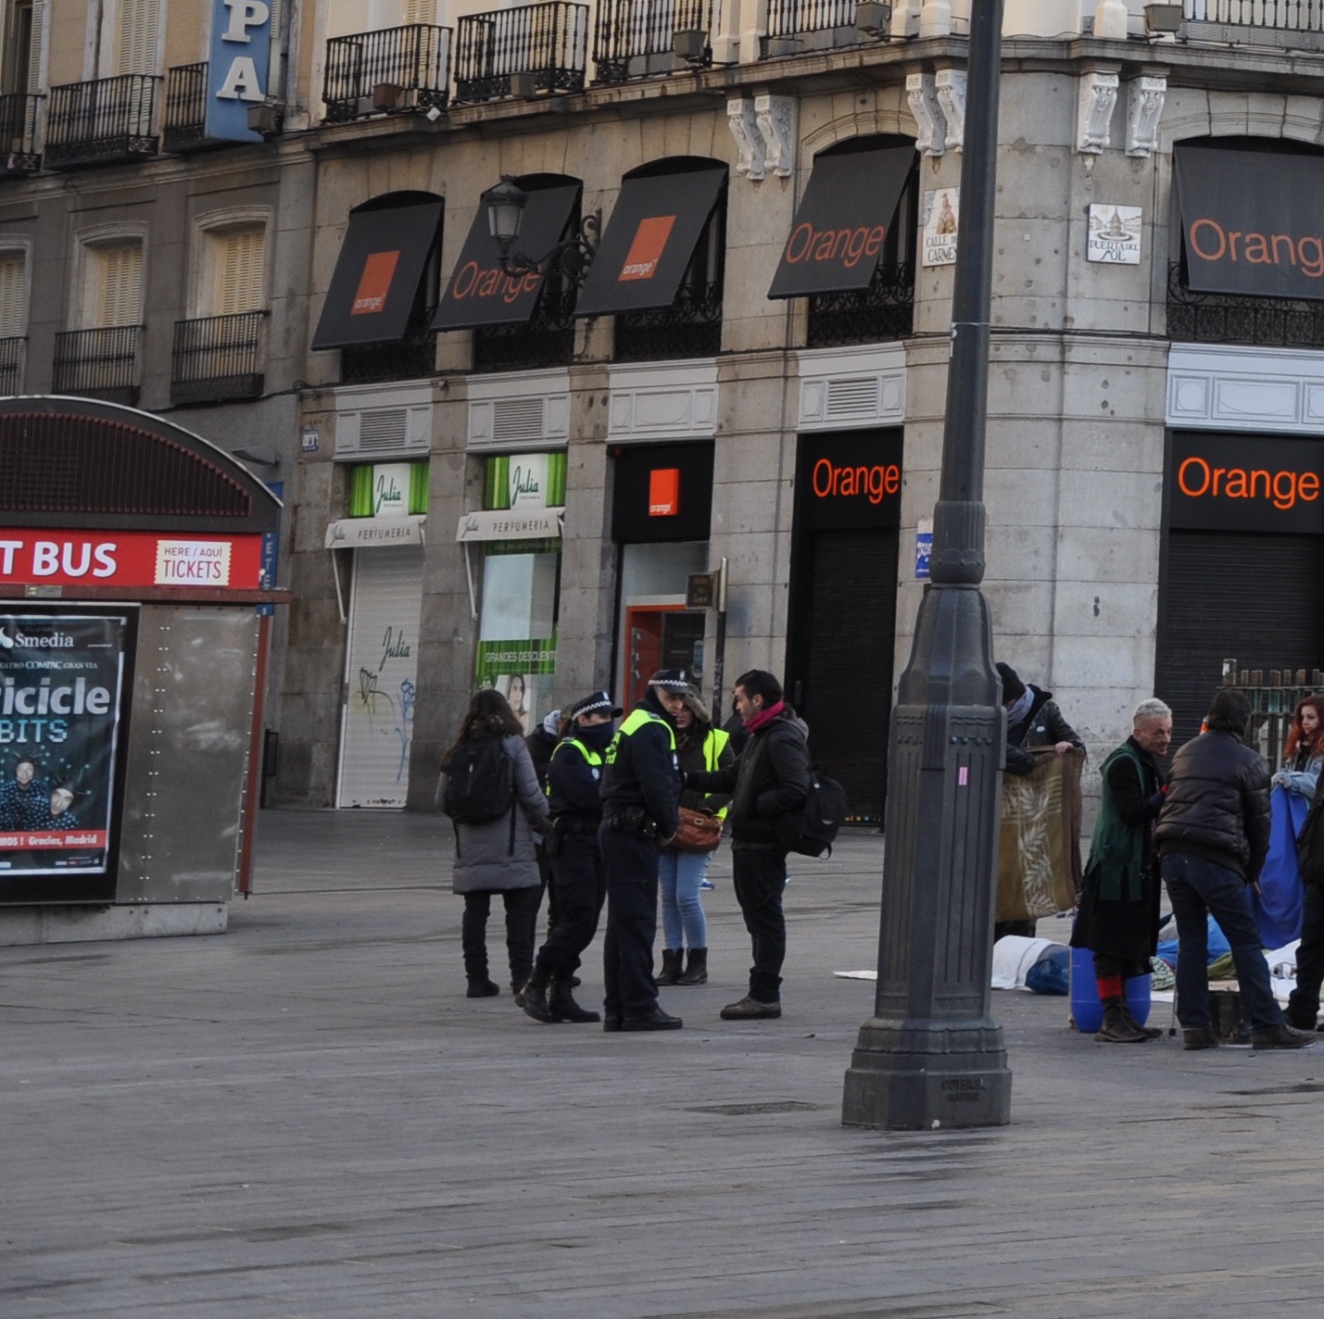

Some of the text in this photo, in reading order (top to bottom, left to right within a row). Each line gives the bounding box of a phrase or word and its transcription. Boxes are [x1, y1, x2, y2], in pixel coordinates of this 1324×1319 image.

[786, 222, 886, 269] Orange
[926, 235, 949, 247] CALLE
[1089, 239, 1125, 252] PUERTA
[453, 260, 542, 303] Orange
[512, 465, 539, 507] Julia
[811, 457, 900, 505] Orange
[1177, 456, 1321, 511] Orange
[375, 474, 402, 514] Julia
[650, 502, 673, 515] orange
[357, 527, 411, 541] PERFUMERIA
[492, 520, 550, 534] PERFUMERIA
[32, 541, 118, 577] BUS
[164, 547, 192, 557] HERE
[199, 545, 223, 558] AQUÍ
[162, 559, 223, 579] TICKETS
[15, 632, 75, 648] Smedia
[378, 625, 411, 672] Julia
[485, 651, 518, 664] GRANDES
[0, 677, 111, 715] icicle
[65, 834, 98, 845] Madrid
